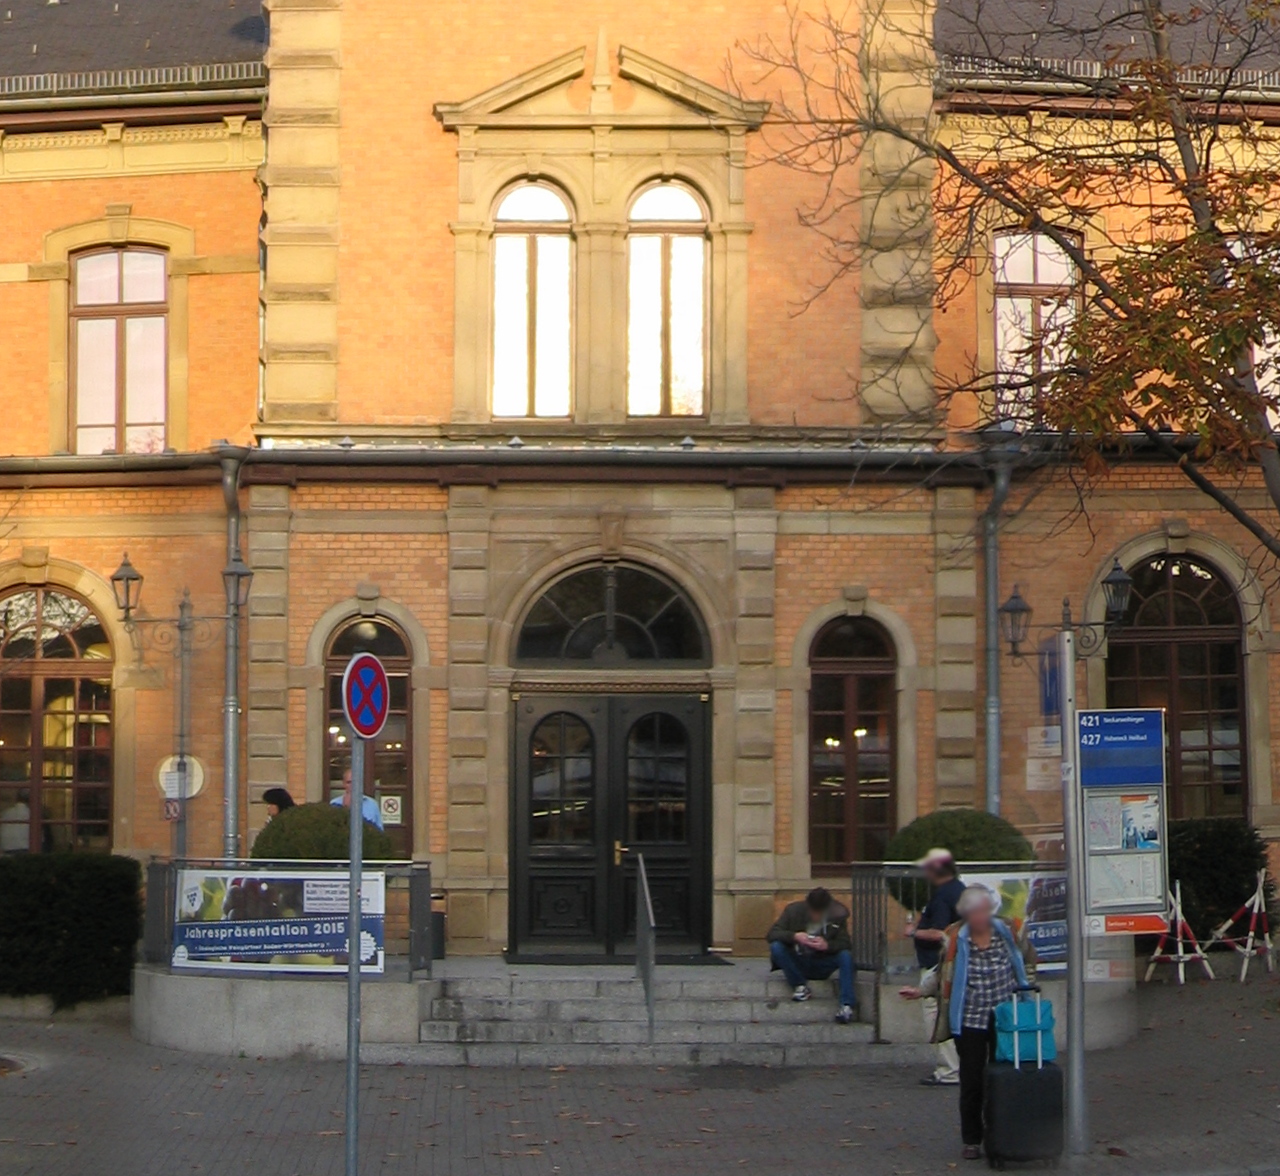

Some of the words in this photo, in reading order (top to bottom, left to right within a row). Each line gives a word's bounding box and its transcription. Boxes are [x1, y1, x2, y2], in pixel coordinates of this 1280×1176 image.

[1080, 715, 1100, 727] 421
[1081, 734, 1101, 745] 427
[184, 925, 309, 941] Jahrespräsentation
[314, 923, 346, 935] 2015
